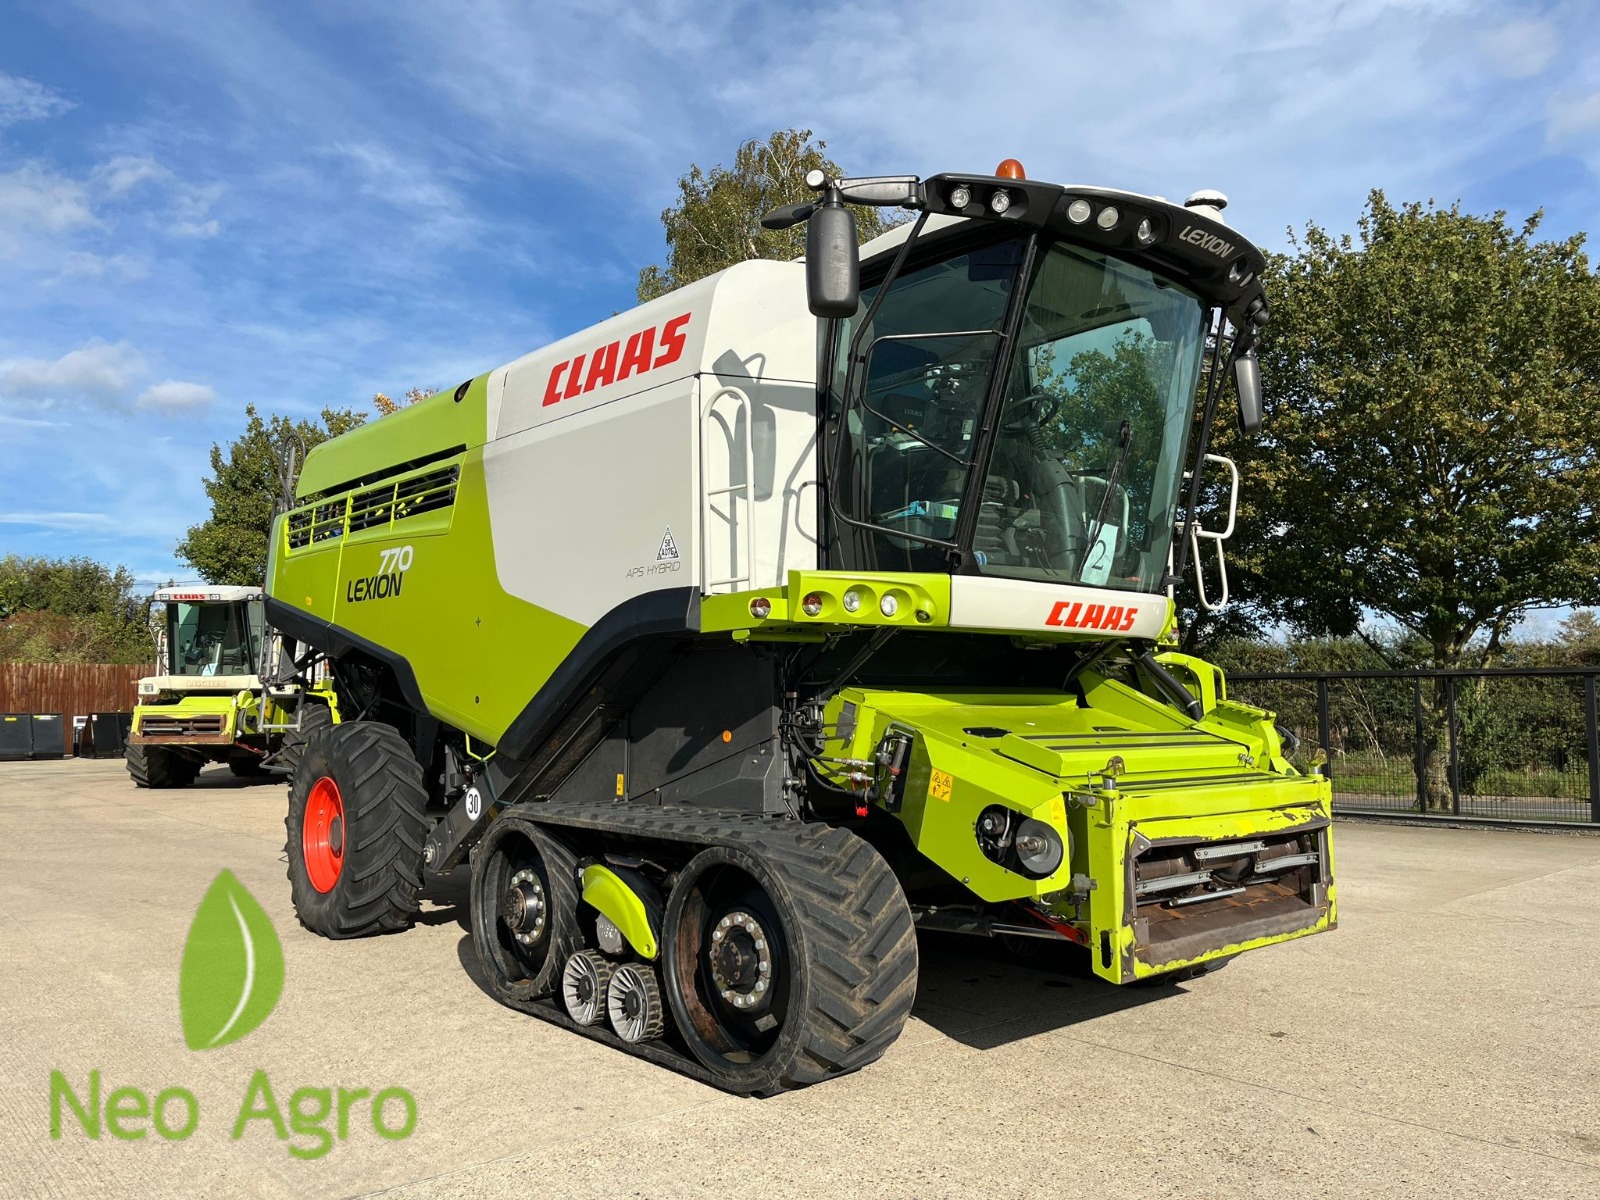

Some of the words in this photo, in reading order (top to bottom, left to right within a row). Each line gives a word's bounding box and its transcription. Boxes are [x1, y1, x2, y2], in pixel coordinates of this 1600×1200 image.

[1178, 225, 1235, 258] LEXION
[542, 311, 692, 407] CLAAS
[377, 545, 414, 575] 770
[626, 566, 644, 578] APS
[647, 561, 680, 575] HYBRID
[1091, 539, 1107, 571] 2
[346, 571, 403, 603] LEXION
[1044, 600, 1139, 631] CLAAS
[186, 680, 227, 688] LEXION
[468, 793, 479, 814] 30
